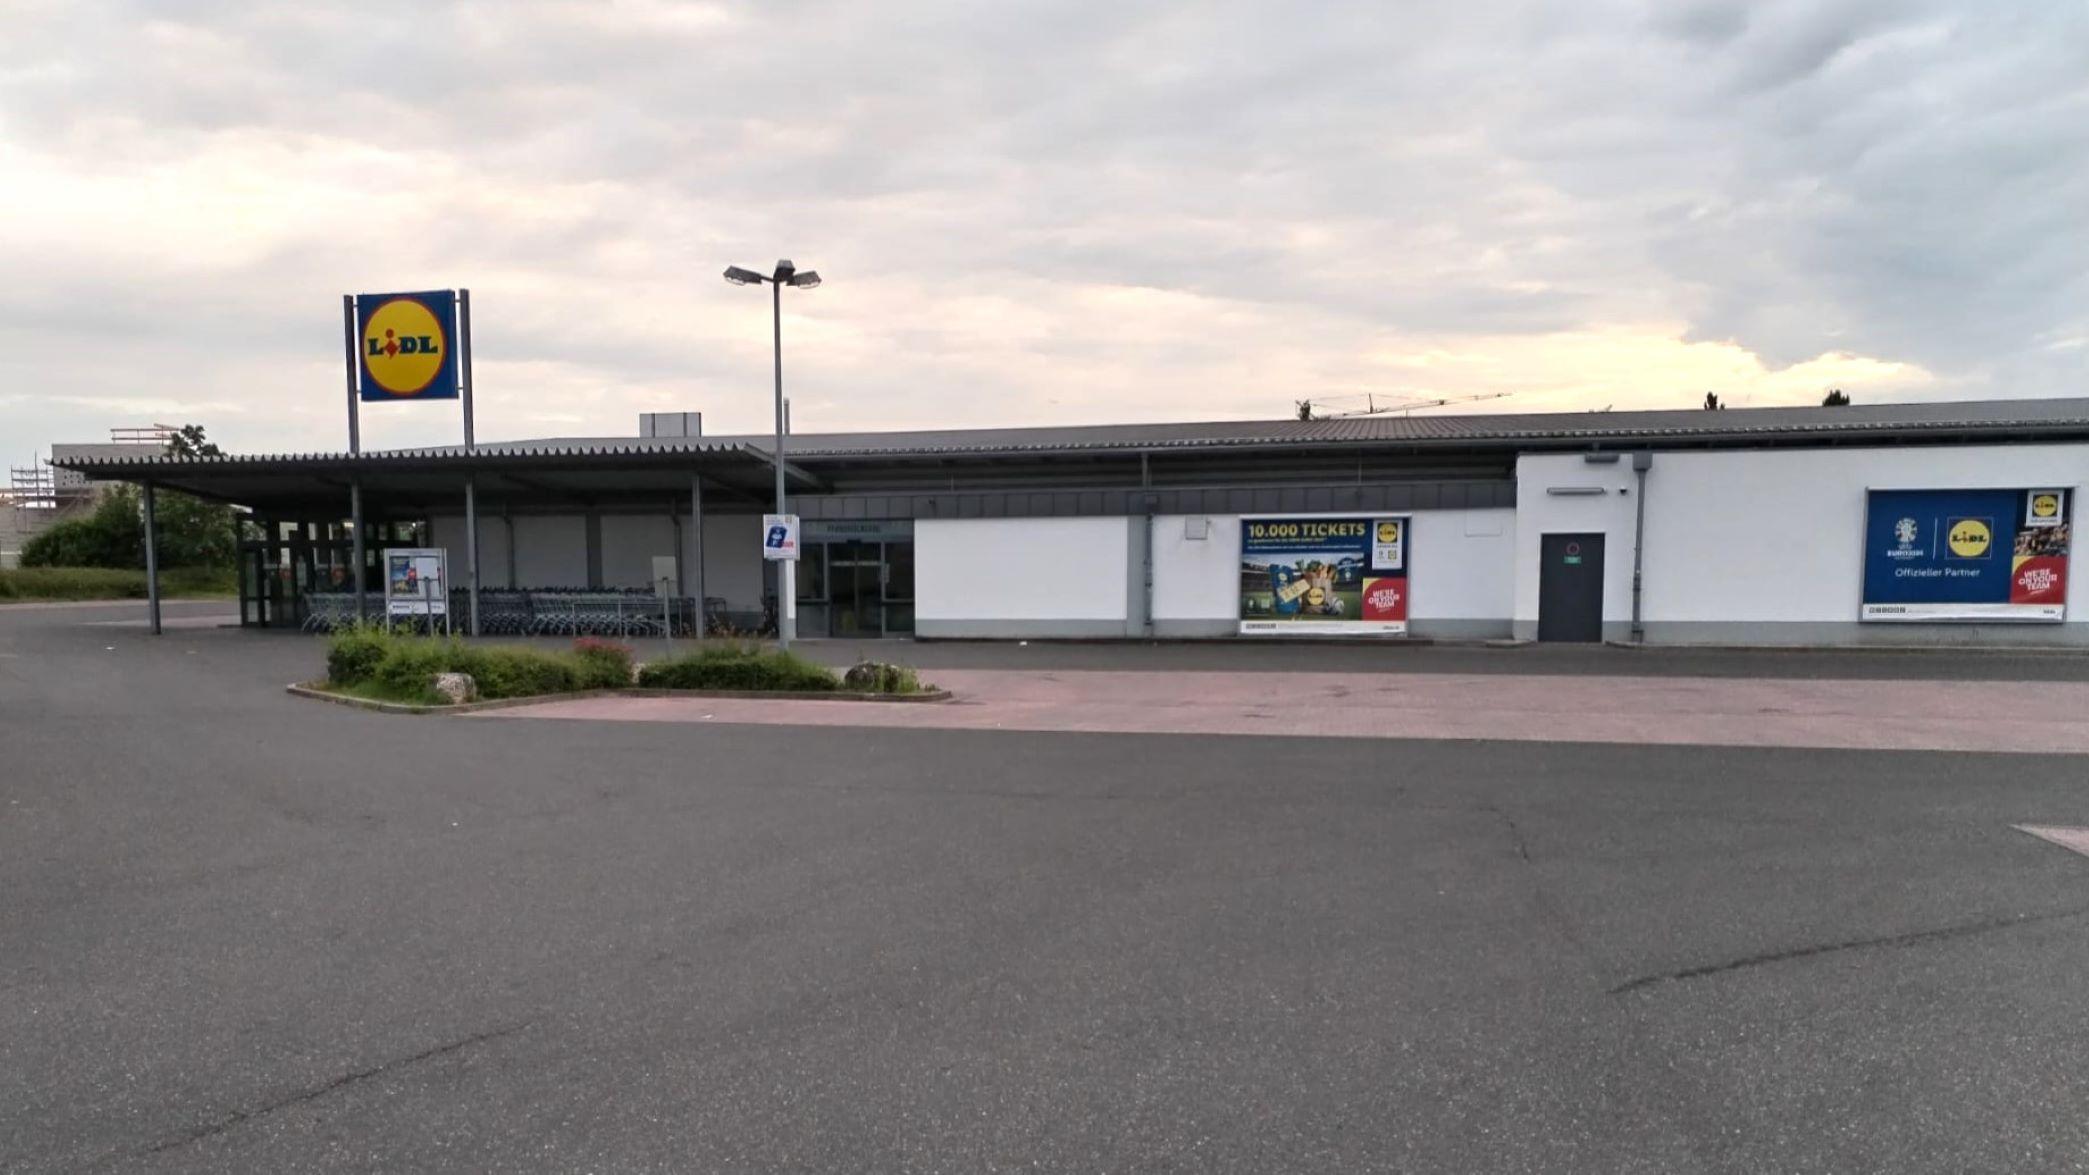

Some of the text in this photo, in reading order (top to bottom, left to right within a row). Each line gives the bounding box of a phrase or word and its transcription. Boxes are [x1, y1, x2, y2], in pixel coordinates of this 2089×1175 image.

[1249, 523, 1366, 538] 10.000 TICKETS
[1895, 567, 1980, 578] Offizieller Partner
[2026, 581, 2051, 590] TEAM
